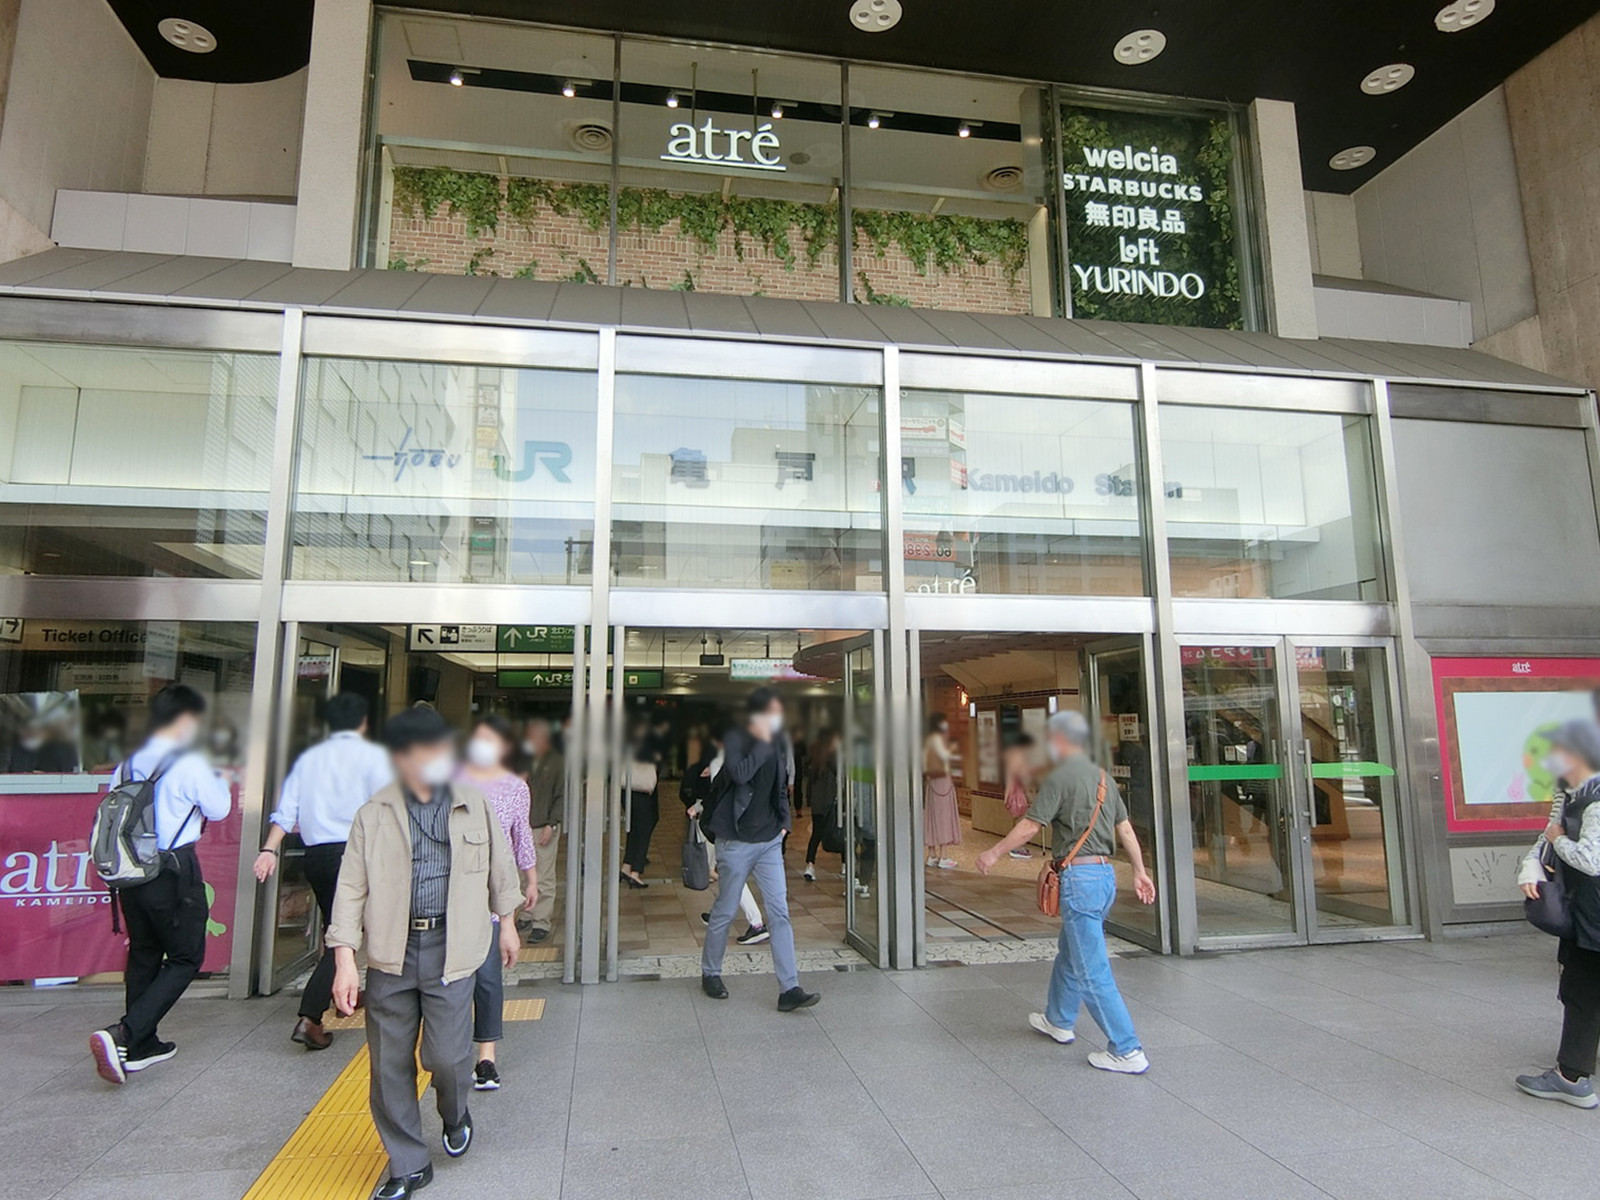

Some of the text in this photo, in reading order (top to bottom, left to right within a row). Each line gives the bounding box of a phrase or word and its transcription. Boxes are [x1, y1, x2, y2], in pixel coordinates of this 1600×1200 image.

[668, 117, 781, 165] atré
[1083, 145, 1177, 175] welcia
[1063, 174, 1203, 202] STARBUCKS
[1085, 201, 1186, 234] 無印良品
[1073, 264, 1205, 299] YURINDO
[493, 440, 573, 483] JR
[967, 469, 1183, 498] Kameido Stan
[42, 629, 93, 643] Ticket
[526, 626, 548, 638] JR
[545, 673, 563, 684] JR
[0, 840, 98, 893] atr
[15, 895, 112, 907] KAMEIDO
